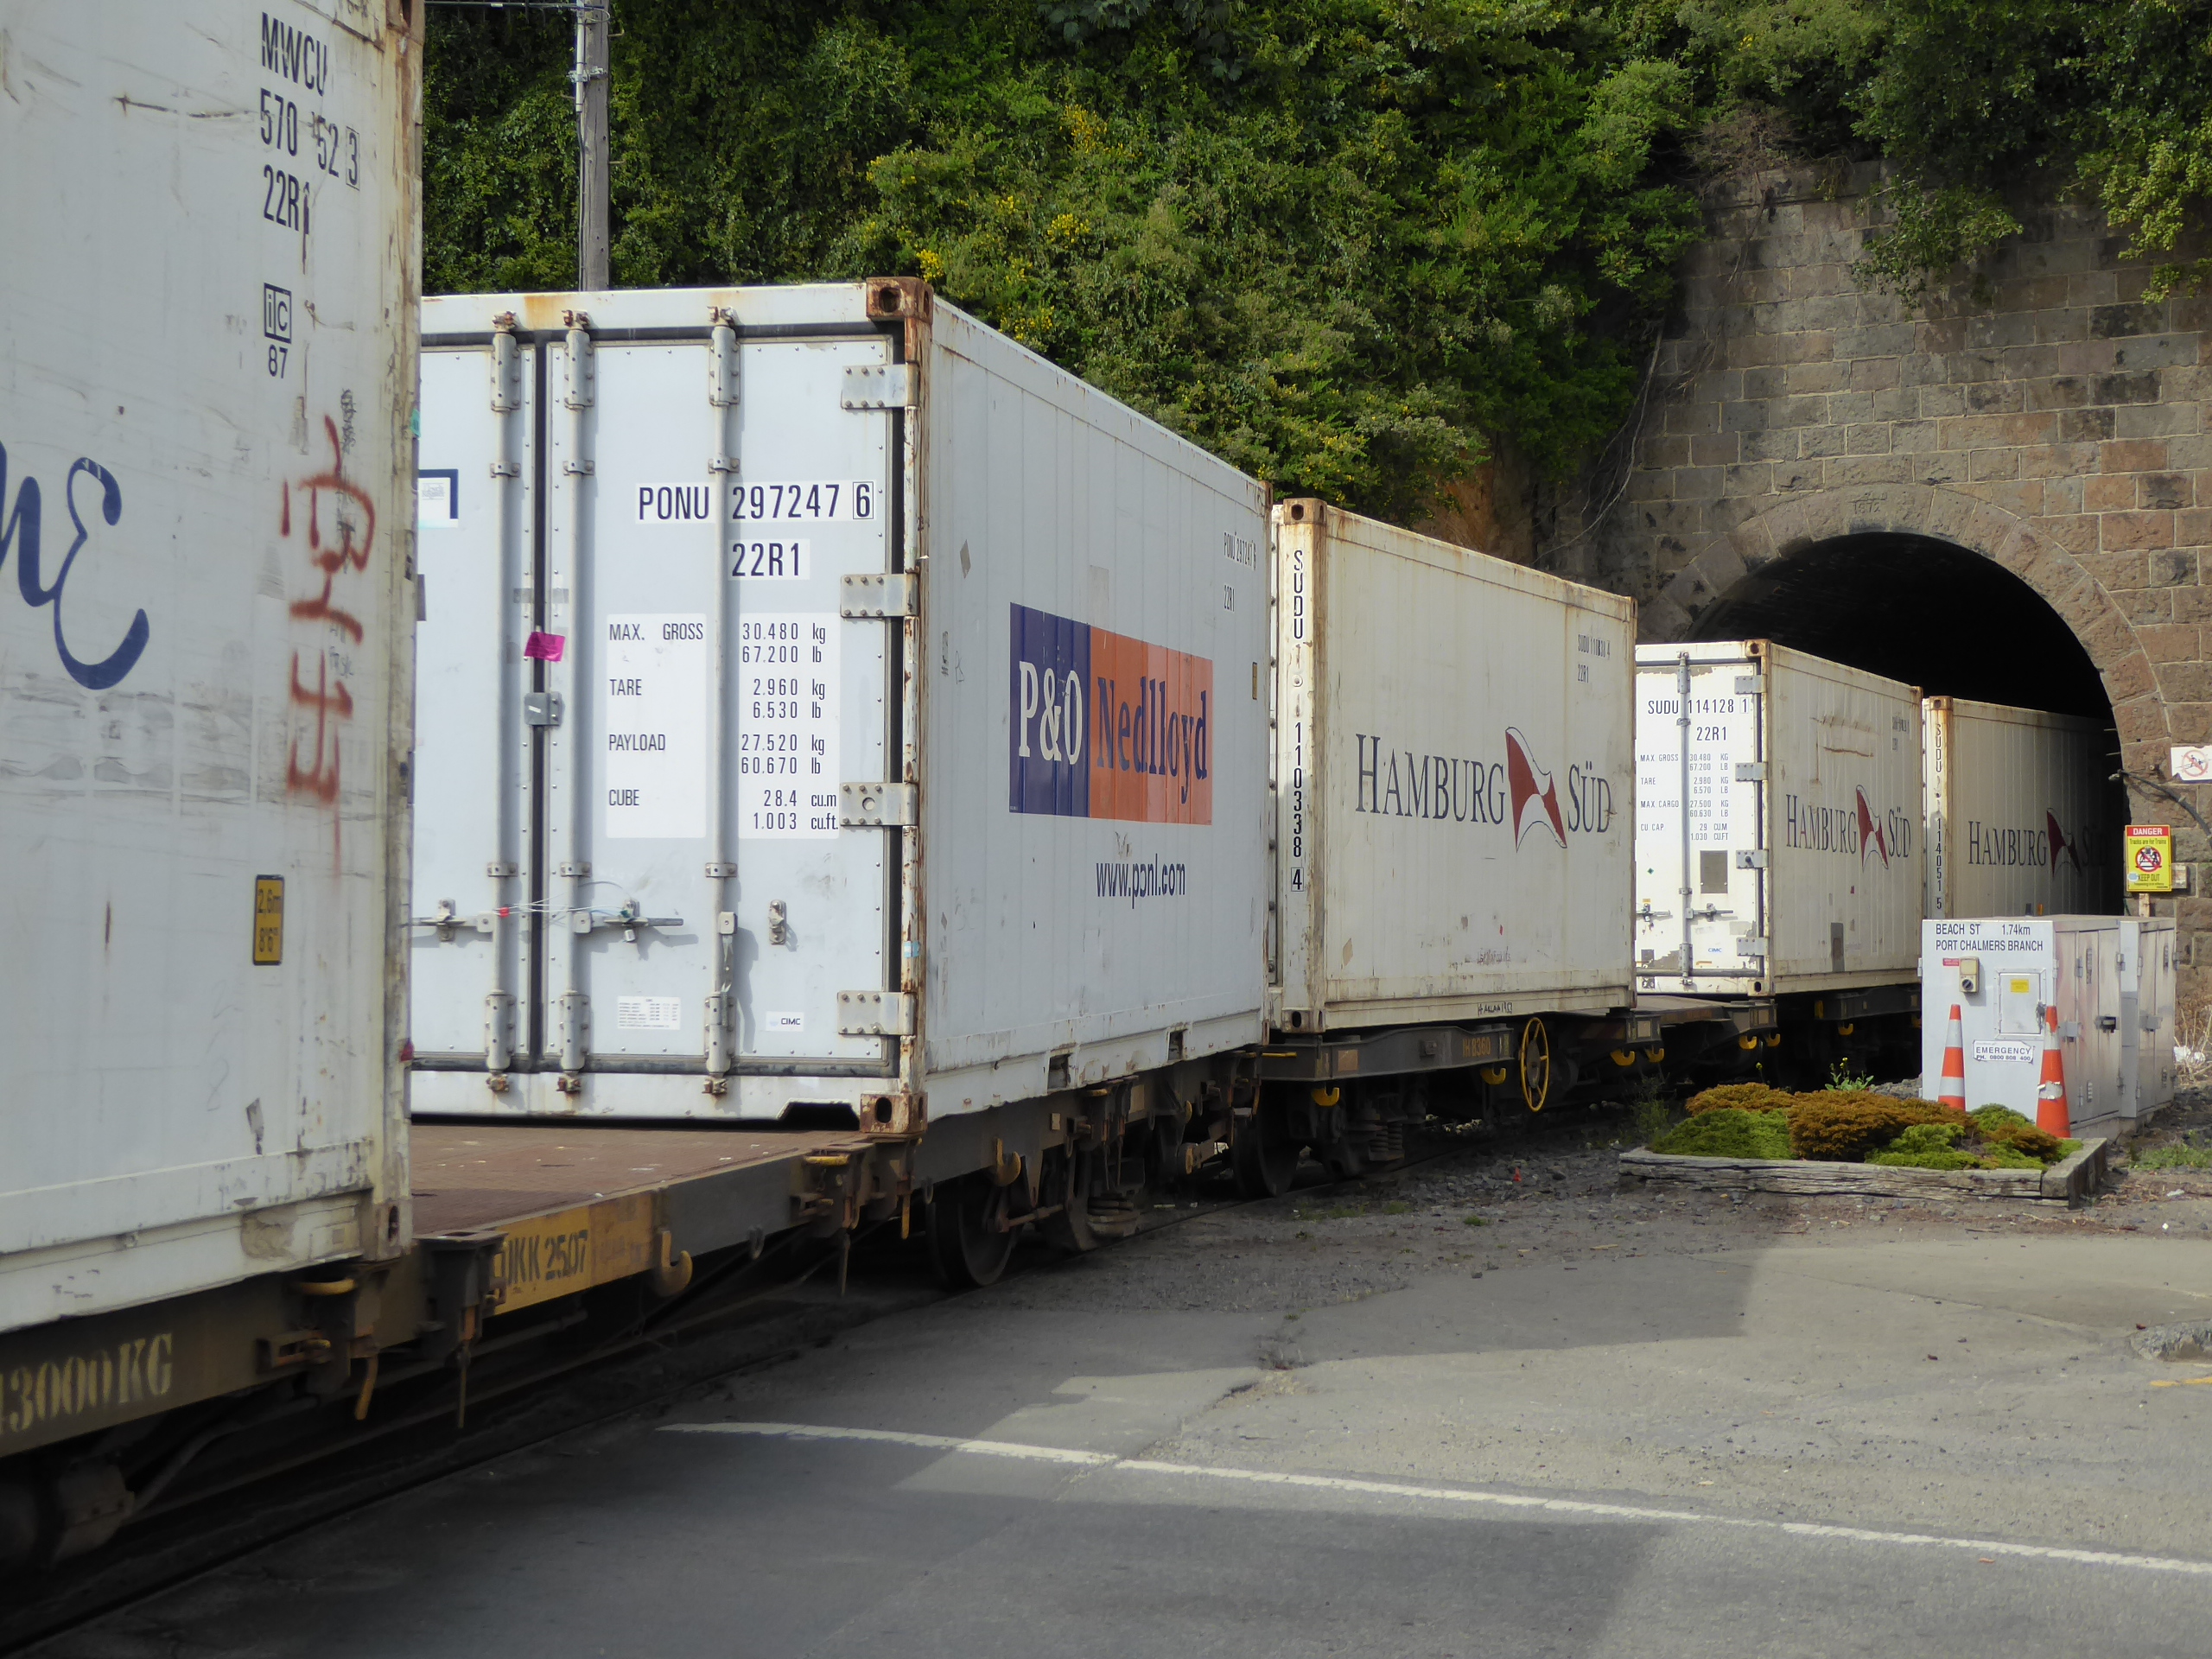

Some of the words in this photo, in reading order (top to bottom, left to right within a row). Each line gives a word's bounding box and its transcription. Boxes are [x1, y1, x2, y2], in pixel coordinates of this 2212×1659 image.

[262, 11, 327, 96] MWCU
[260, 87, 297, 156] 570
[348, 132, 358, 185] 3
[264, 164, 309, 235] 22R1
[269, 345, 289, 379] 87
[639, 486, 710, 519] PONU
[733, 484, 841, 519] 297247
[856, 484, 871, 518] 6
[732, 543, 800, 576] 22R1
[1294, 550, 1303, 639] SUDU
[609, 623, 645, 641] MAX.
[663, 623, 704, 640] GROSS
[742, 622, 798, 640] 30.480
[812, 623, 826, 644] kg
[742, 646, 798, 663] 67.200
[812, 646, 822, 663] lb
[609, 679, 642, 696] TARE
[753, 678, 798, 696] 2.960
[811, 678, 825, 700] kg
[753, 702, 798, 719] 6.530
[811, 702, 822, 719] lb
[1648, 700, 1679, 715] SUDU
[1688, 698, 1734, 714] 114128
[1019, 660, 1083, 765] P&O
[1096, 676, 1207, 804] Nedlloyd
[1696, 726, 1727, 741] 22R1
[608, 734, 666, 751] PAYLOAD
[741, 734, 798, 752] 27.520
[811, 734, 825, 755] kg
[741, 757, 798, 774] 60.670
[810, 757, 821, 774] lb
[1658, 753, 1679, 762] GROSS
[1294, 721, 1302, 857] 110338
[1356, 733, 1505, 825] HAMBURG
[1567, 760, 1611, 833] SÜD
[1694, 776, 1711, 785] 2.980
[608, 790, 640, 806] CUBE
[764, 790, 798, 807] 28.4
[810, 791, 837, 807] cu.m
[753, 812, 798, 830] 1.003
[1699, 823, 1707, 831] 29
[1786, 794, 1857, 855] HAMBURG
[1888, 806, 1911, 858] SÜD
[2133, 827, 2163, 836] DANGER
[1968, 821, 2047, 867] HAMBURG
[1292, 868, 1303, 890] 4
[1936, 897, 1942, 909] 5
[1936, 924, 1965, 935] BEACH
[1969, 924, 1980, 935] ST
[2002, 924, 2031, 935] 1.74km
[1936, 940, 1957, 950] PORT
[1960, 940, 2005, 951] CHALMERS
[2008, 940, 2044, 951] BRANCH
[0, 1333, 173, 1434] 3000KG
